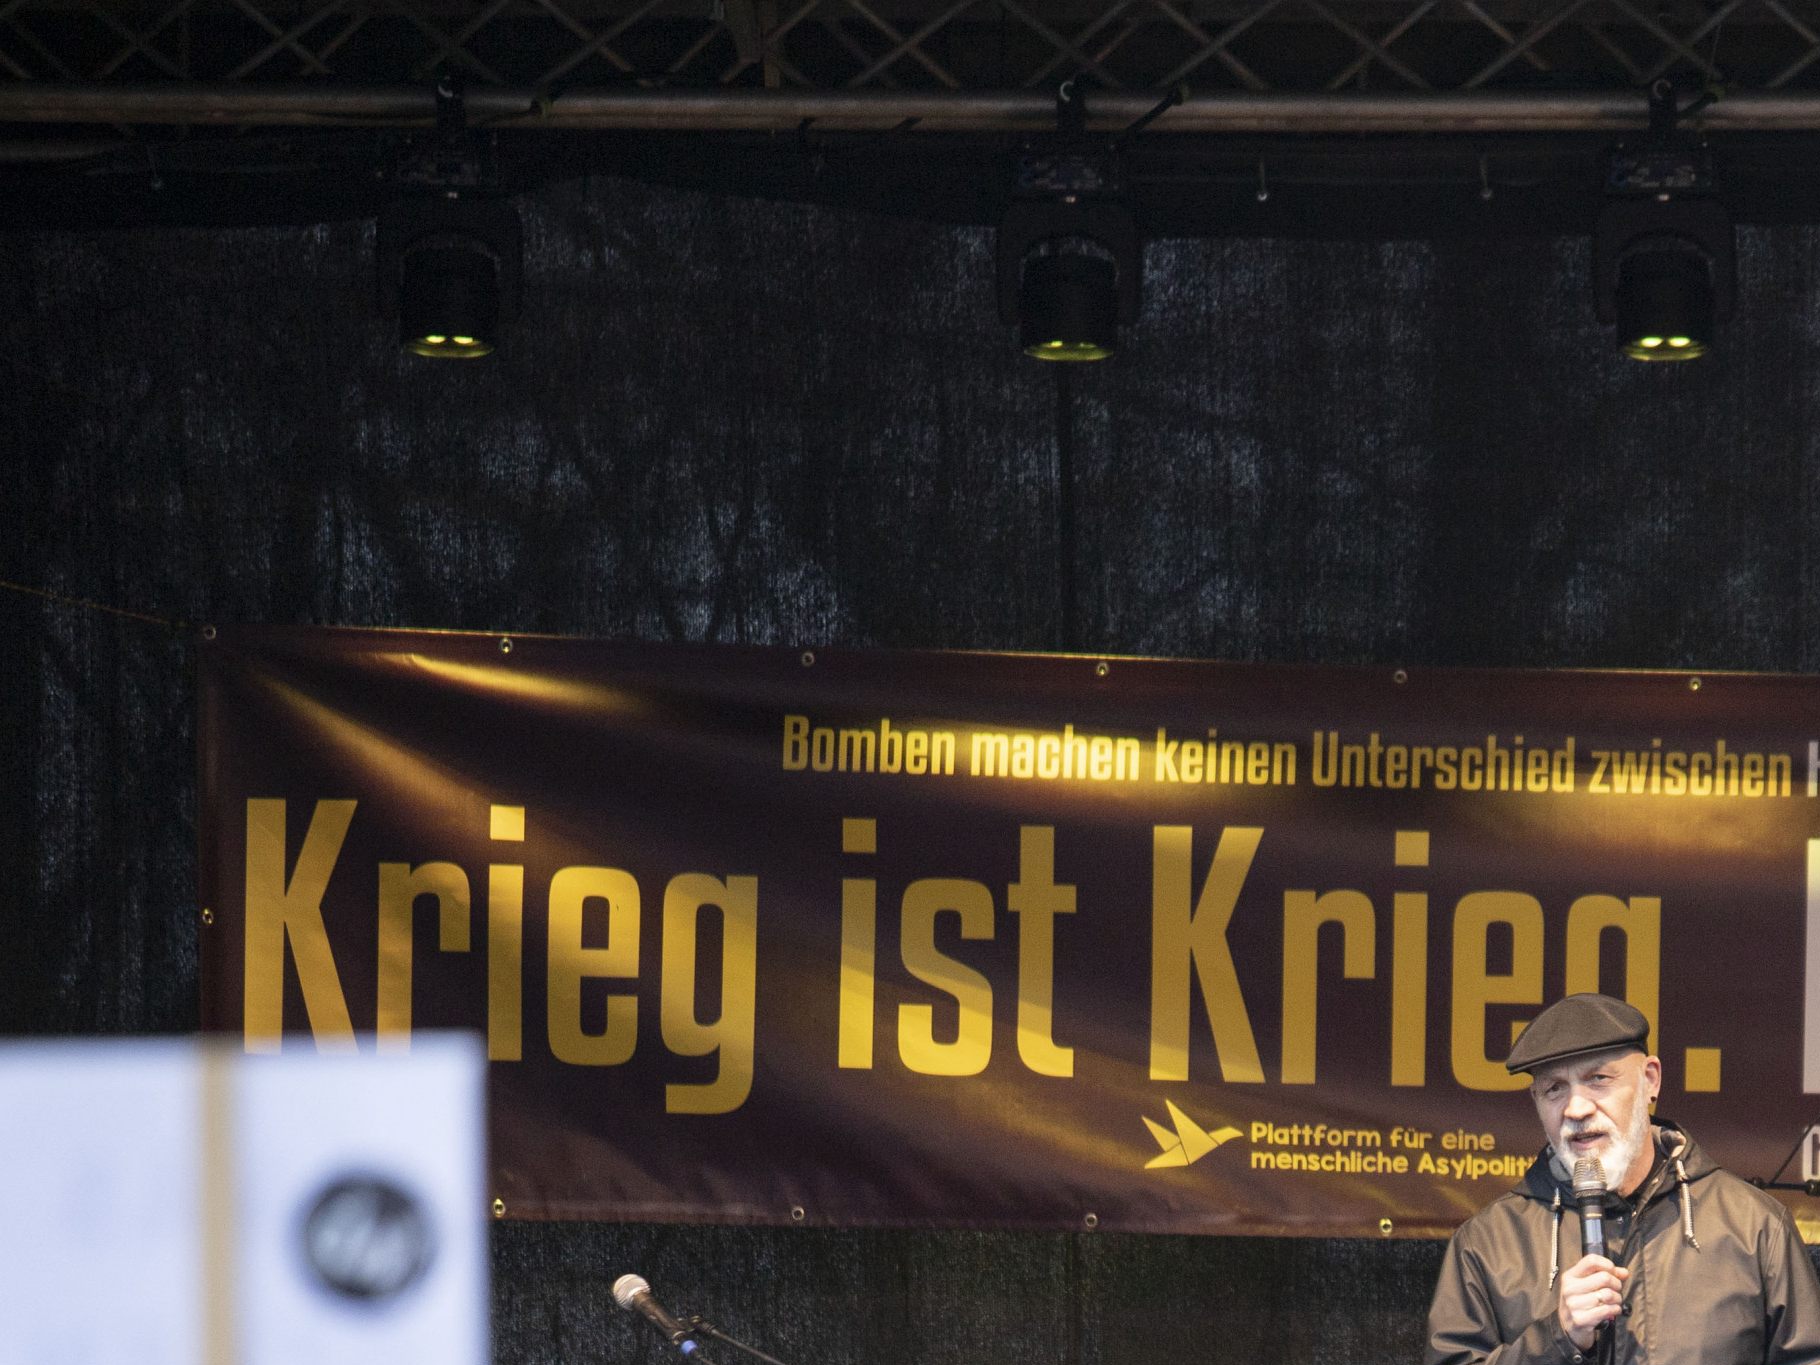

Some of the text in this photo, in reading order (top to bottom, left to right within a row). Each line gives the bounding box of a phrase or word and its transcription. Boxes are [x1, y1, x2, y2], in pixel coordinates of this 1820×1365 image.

[782, 714, 955, 776] Bomben
[970, 723, 1140, 782] machen
[1155, 727, 1297, 786] keinen
[1312, 731, 1576, 793] Unterschied
[1588, 738, 1792, 798] zwischen
[244, 798, 760, 1115] Krieg
[838, 818, 1077, 1078] ist
[1251, 1121, 1496, 1151] Plattform für eine
[1251, 1150, 1409, 1174] menschliche
